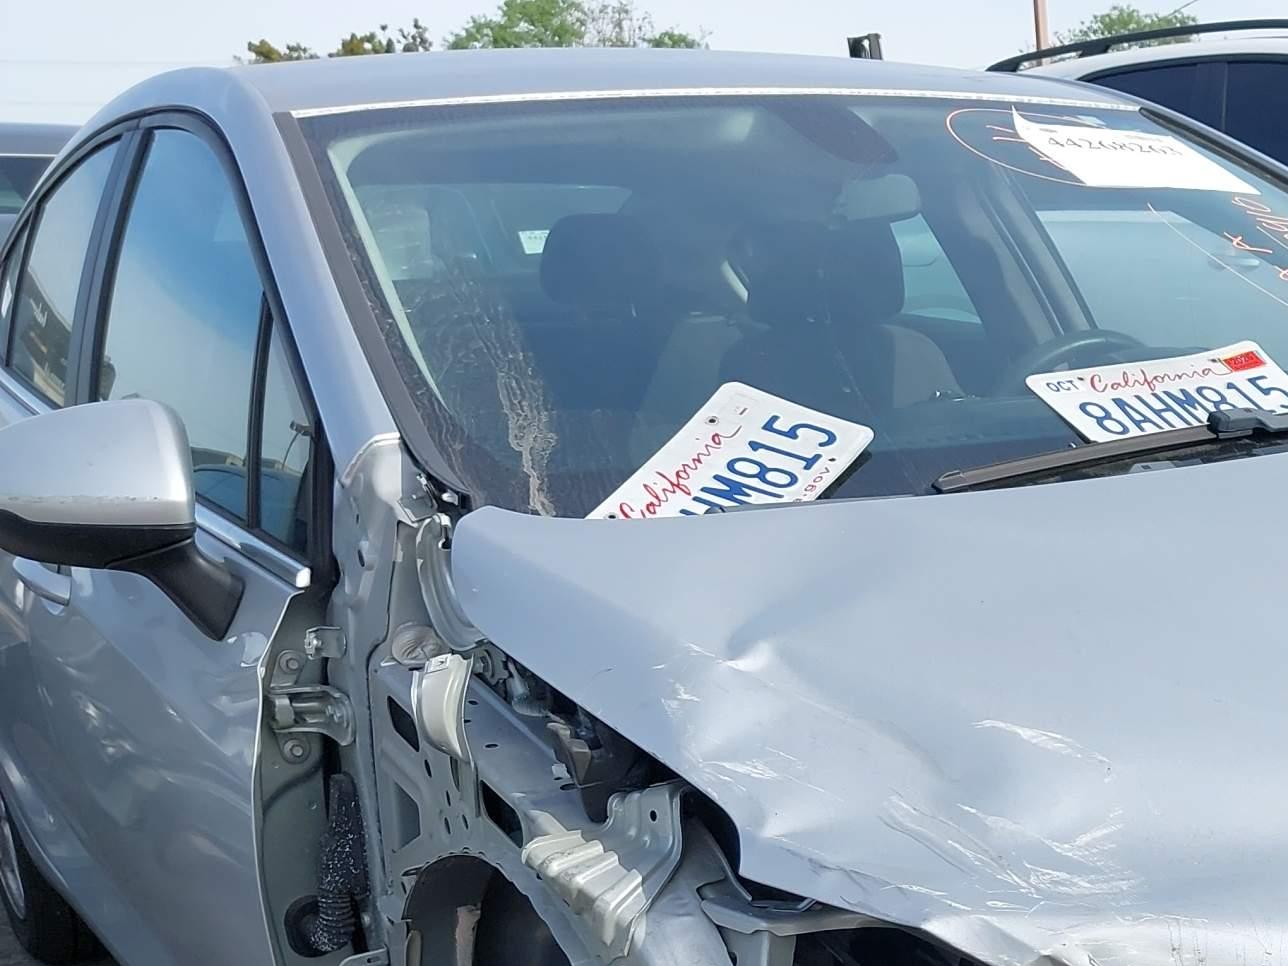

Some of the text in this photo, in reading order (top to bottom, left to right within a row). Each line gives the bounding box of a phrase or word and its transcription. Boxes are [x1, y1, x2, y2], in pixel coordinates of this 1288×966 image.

[1046, 357, 1232, 393] OCT California
[619, 424, 742, 519] California
